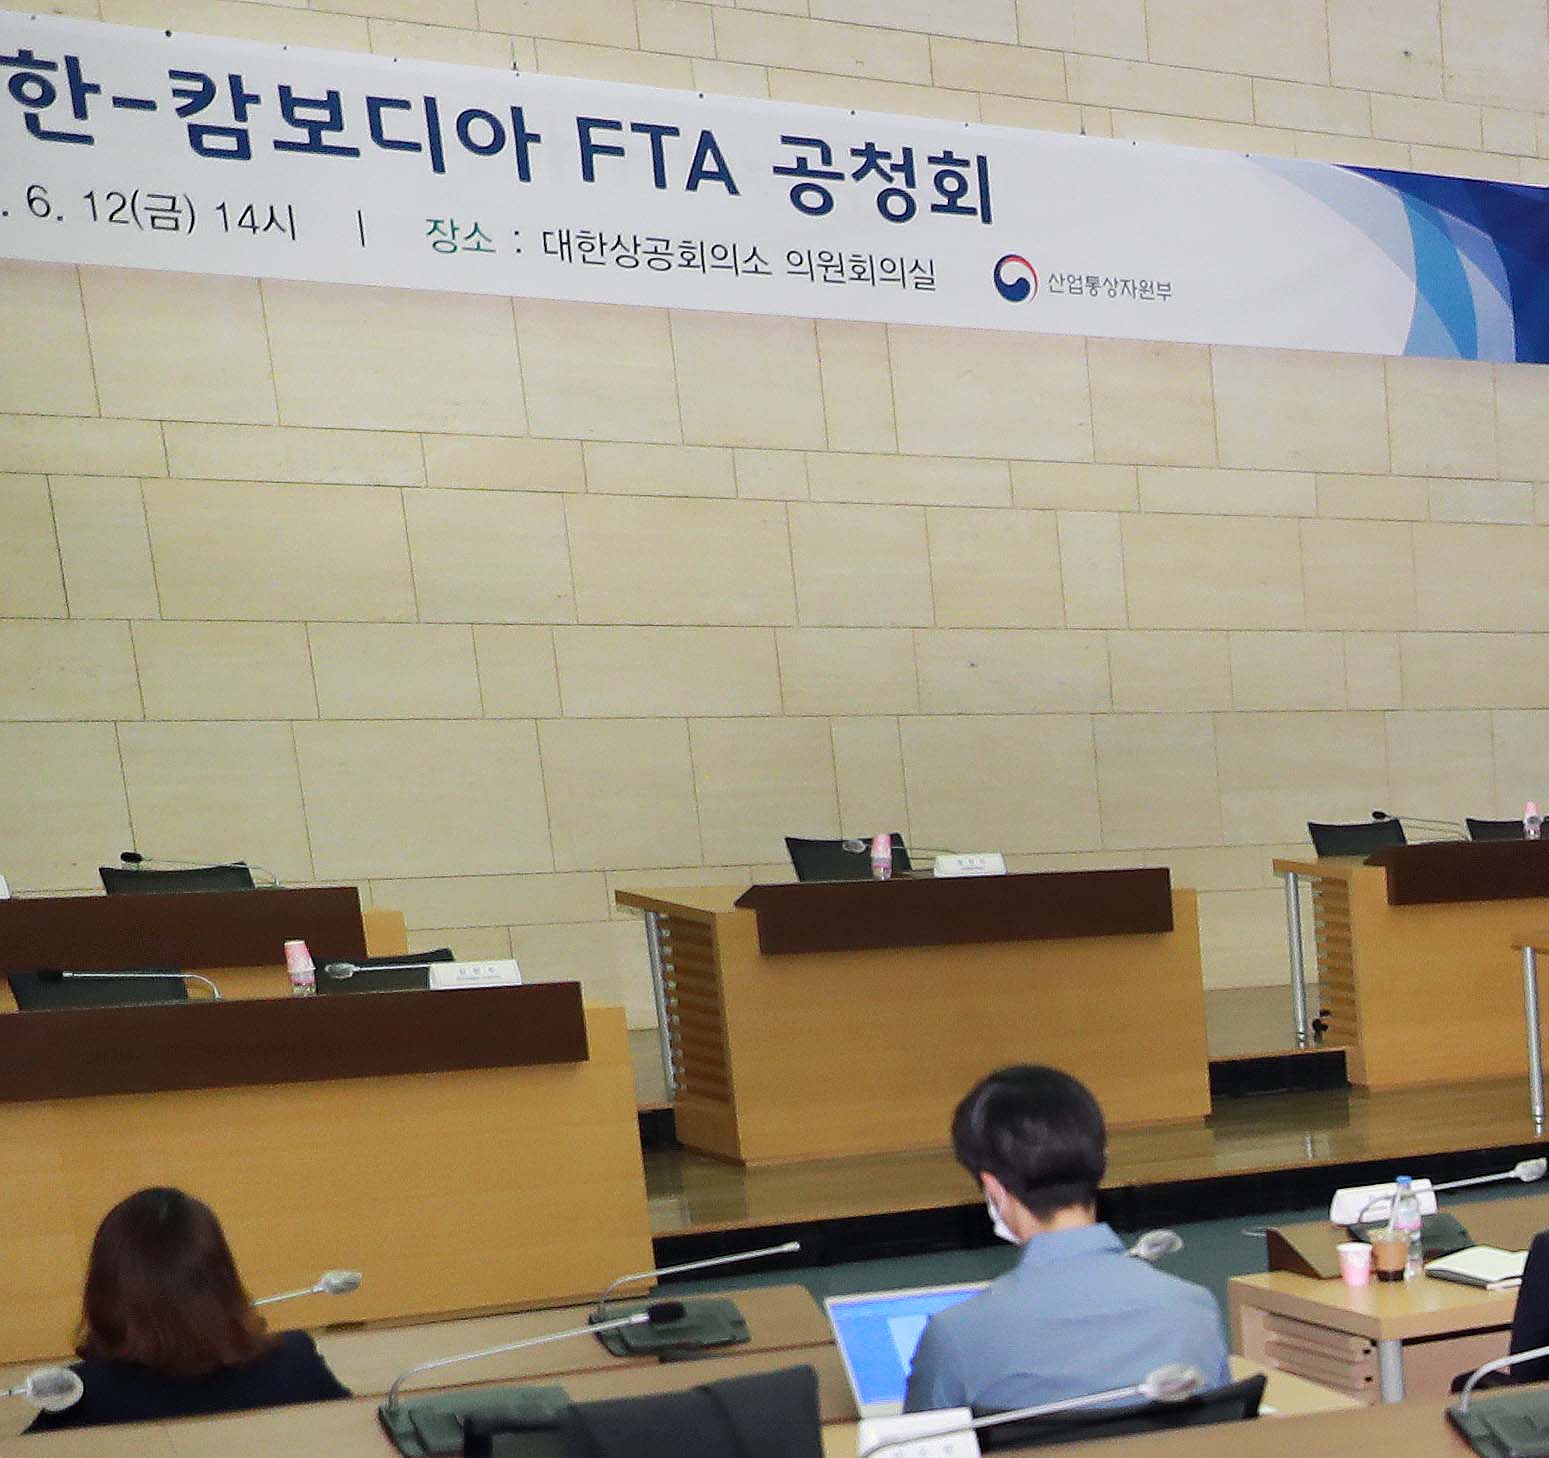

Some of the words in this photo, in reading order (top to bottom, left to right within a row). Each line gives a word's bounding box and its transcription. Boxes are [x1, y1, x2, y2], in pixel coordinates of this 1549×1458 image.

[0, 47, 542, 183] 한-캄보디아
[575, 115, 741, 197] FTA
[771, 131, 995, 226] 공청회
[25, 184, 64, 222] 6.
[83, 189, 196, 235] 12(금)
[215, 201, 297, 241] 14시
[425, 217, 496, 255] 장소
[542, 228, 774, 277] 대한상공회의소
[785, 248, 937, 292] 의원회의실
[1048, 272, 1172, 303] 산업통상자원부
